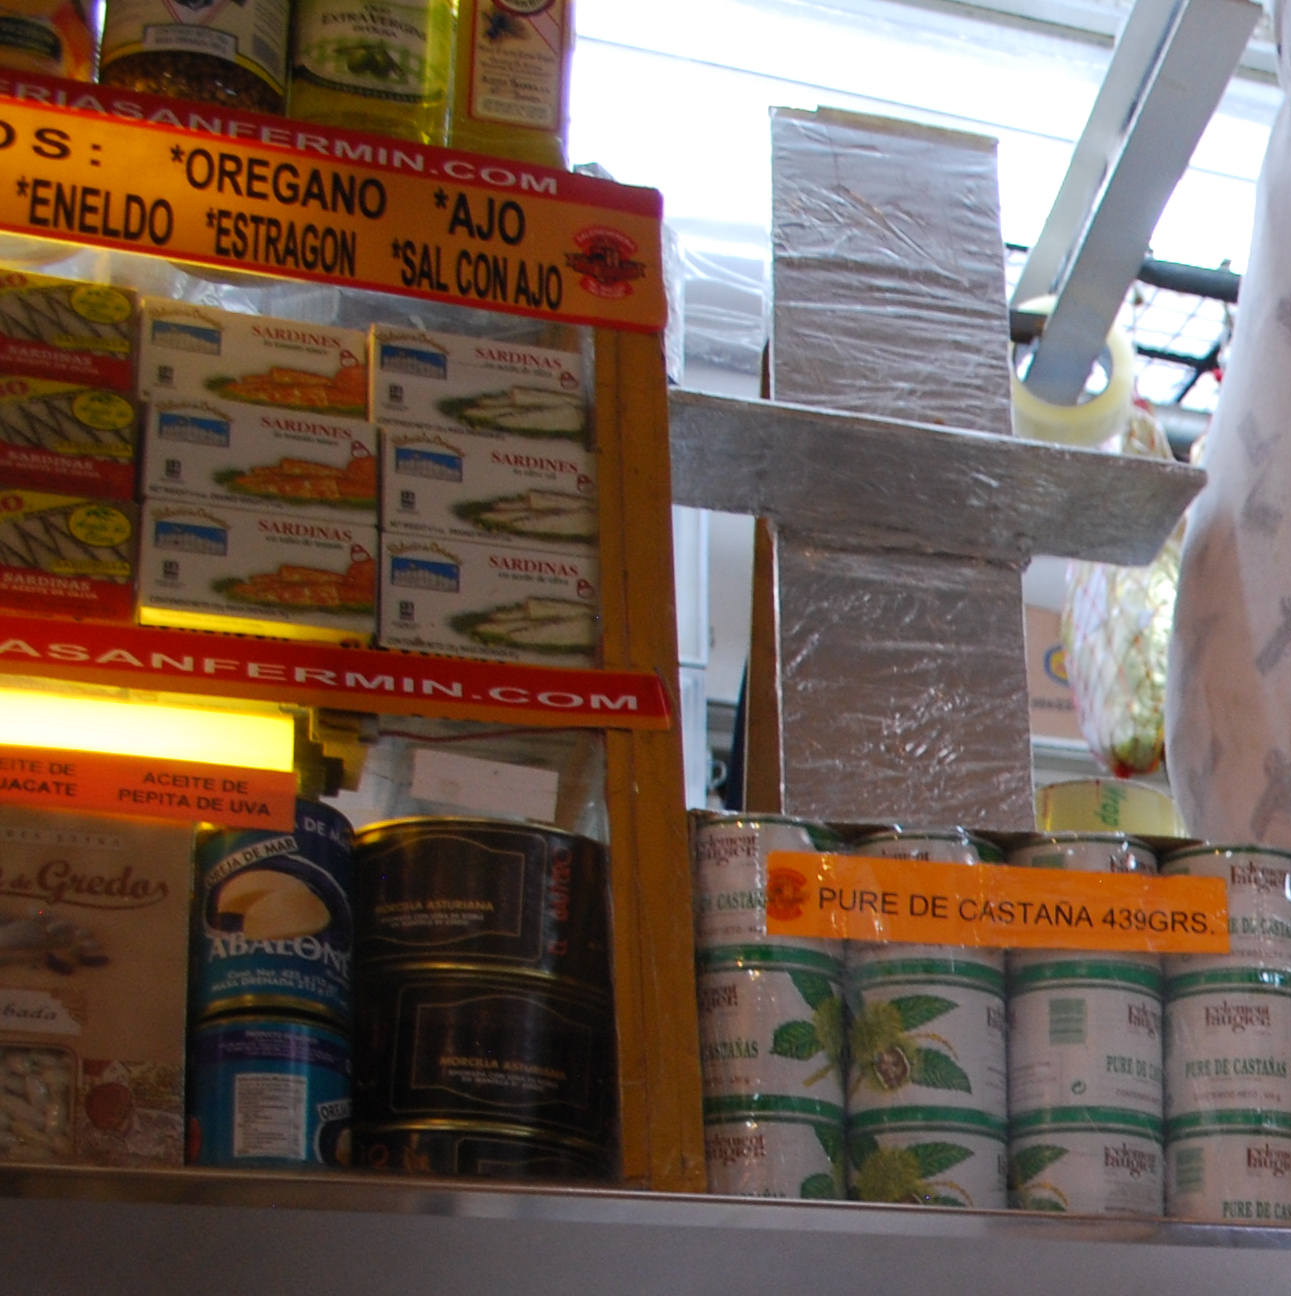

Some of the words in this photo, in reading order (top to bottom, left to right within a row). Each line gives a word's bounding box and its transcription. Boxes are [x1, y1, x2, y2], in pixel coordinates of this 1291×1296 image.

[455, 251, 508, 304] CON
[515, 261, 564, 312] AJO
[251, 324, 342, 348] SARDINES
[8, 344, 93, 366] SARDINAS
[475, 347, 563, 369] SARDINAS
[261, 416, 353, 440] SARDINES
[6, 450, 95, 471] SARDINAS
[491, 452, 580, 474] SARDINES
[259, 519, 354, 542] SARDINAS
[489, 556, 579, 578] SARDINAS
[3, 572, 92, 592] SARDINAS
[143, 771, 216, 792] ACEITE
[221, 778, 250, 795] DE
[118, 788, 191, 809] PEPITA
[196, 797, 224, 812] DE
[229, 800, 271, 818] UVA
[243, 846, 260, 862] DE
[265, 836, 297, 856] MAR
[36, 859, 170, 906] Gredos
[818, 886, 899, 916] PURE
[909, 895, 949, 920] DE
[958, 896, 1094, 930] CASTAÑA
[1101, 904, 1217, 937] 439GRS.
[206, 932, 351, 980] ABALONE
[439, 1055, 499, 1070] MORCILLA
[1106, 1055, 1133, 1074] PURE
[1136, 1058, 1148, 1075] DE
[1215, 1056, 1229, 1074] DE
[1232, 1055, 1287, 1079] CASTAÑAS
[1222, 1200, 1250, 1219] PURE
[1256, 1201, 1271, 1219] DE
